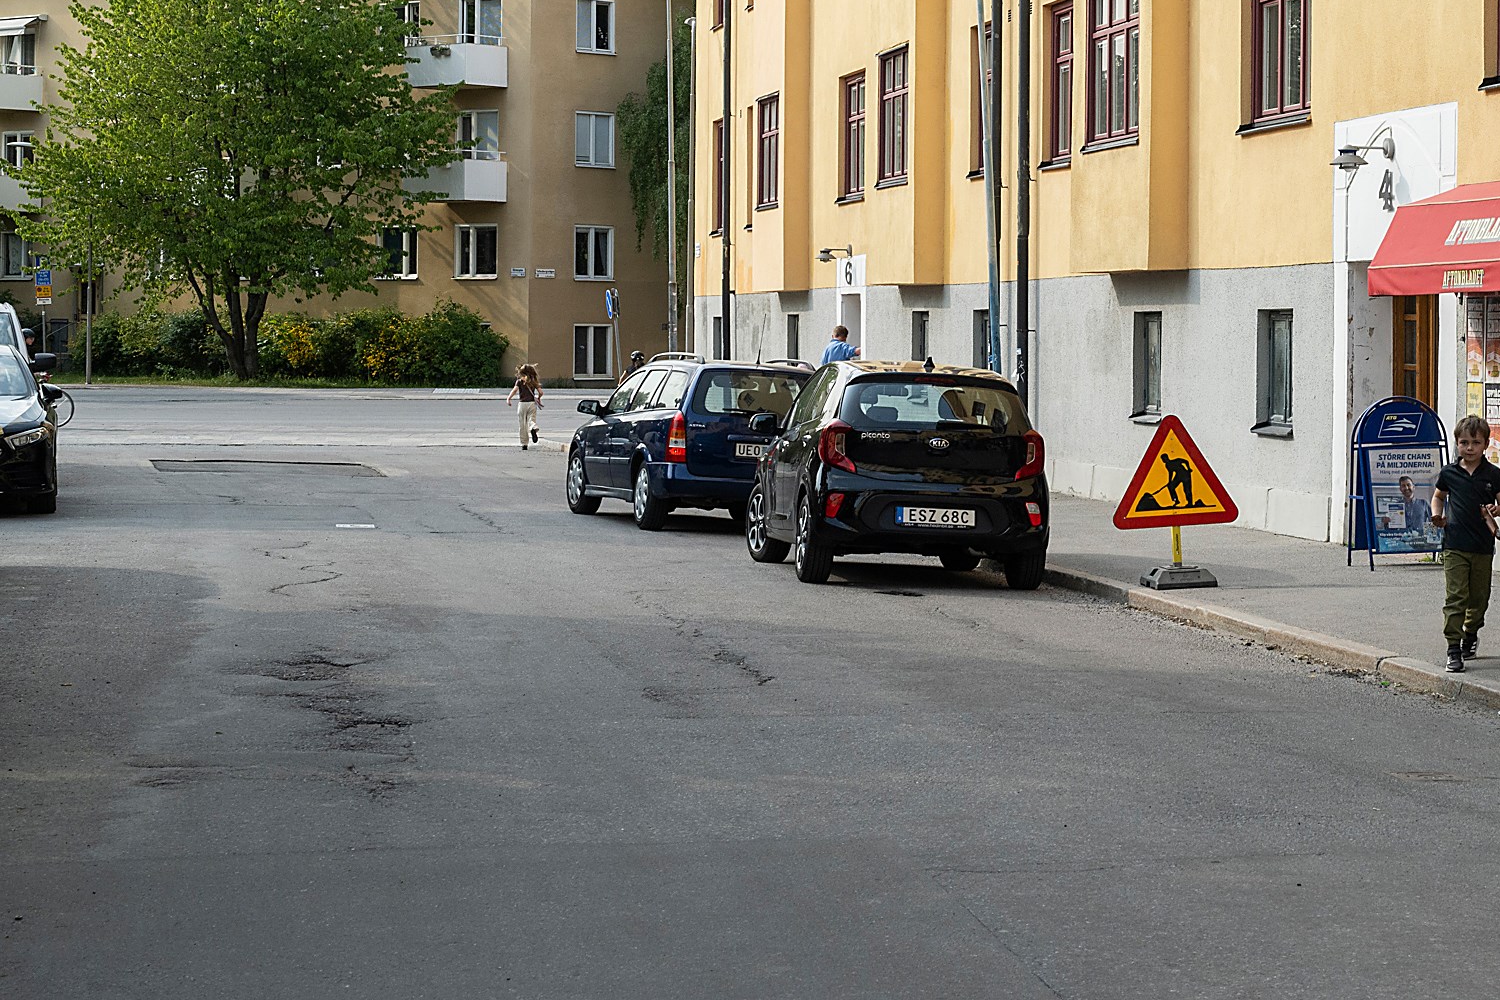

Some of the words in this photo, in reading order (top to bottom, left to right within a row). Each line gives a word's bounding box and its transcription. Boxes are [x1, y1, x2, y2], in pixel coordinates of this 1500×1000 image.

[845, 261, 852, 286] 6
[1442, 269, 1484, 289] AFTONBLADET
[1376, 460, 1386, 468] PÅ
[1378, 452, 1406, 460] STÖRRE
[909, 508, 936, 522] ESZ
[940, 510, 969, 524] 68C
